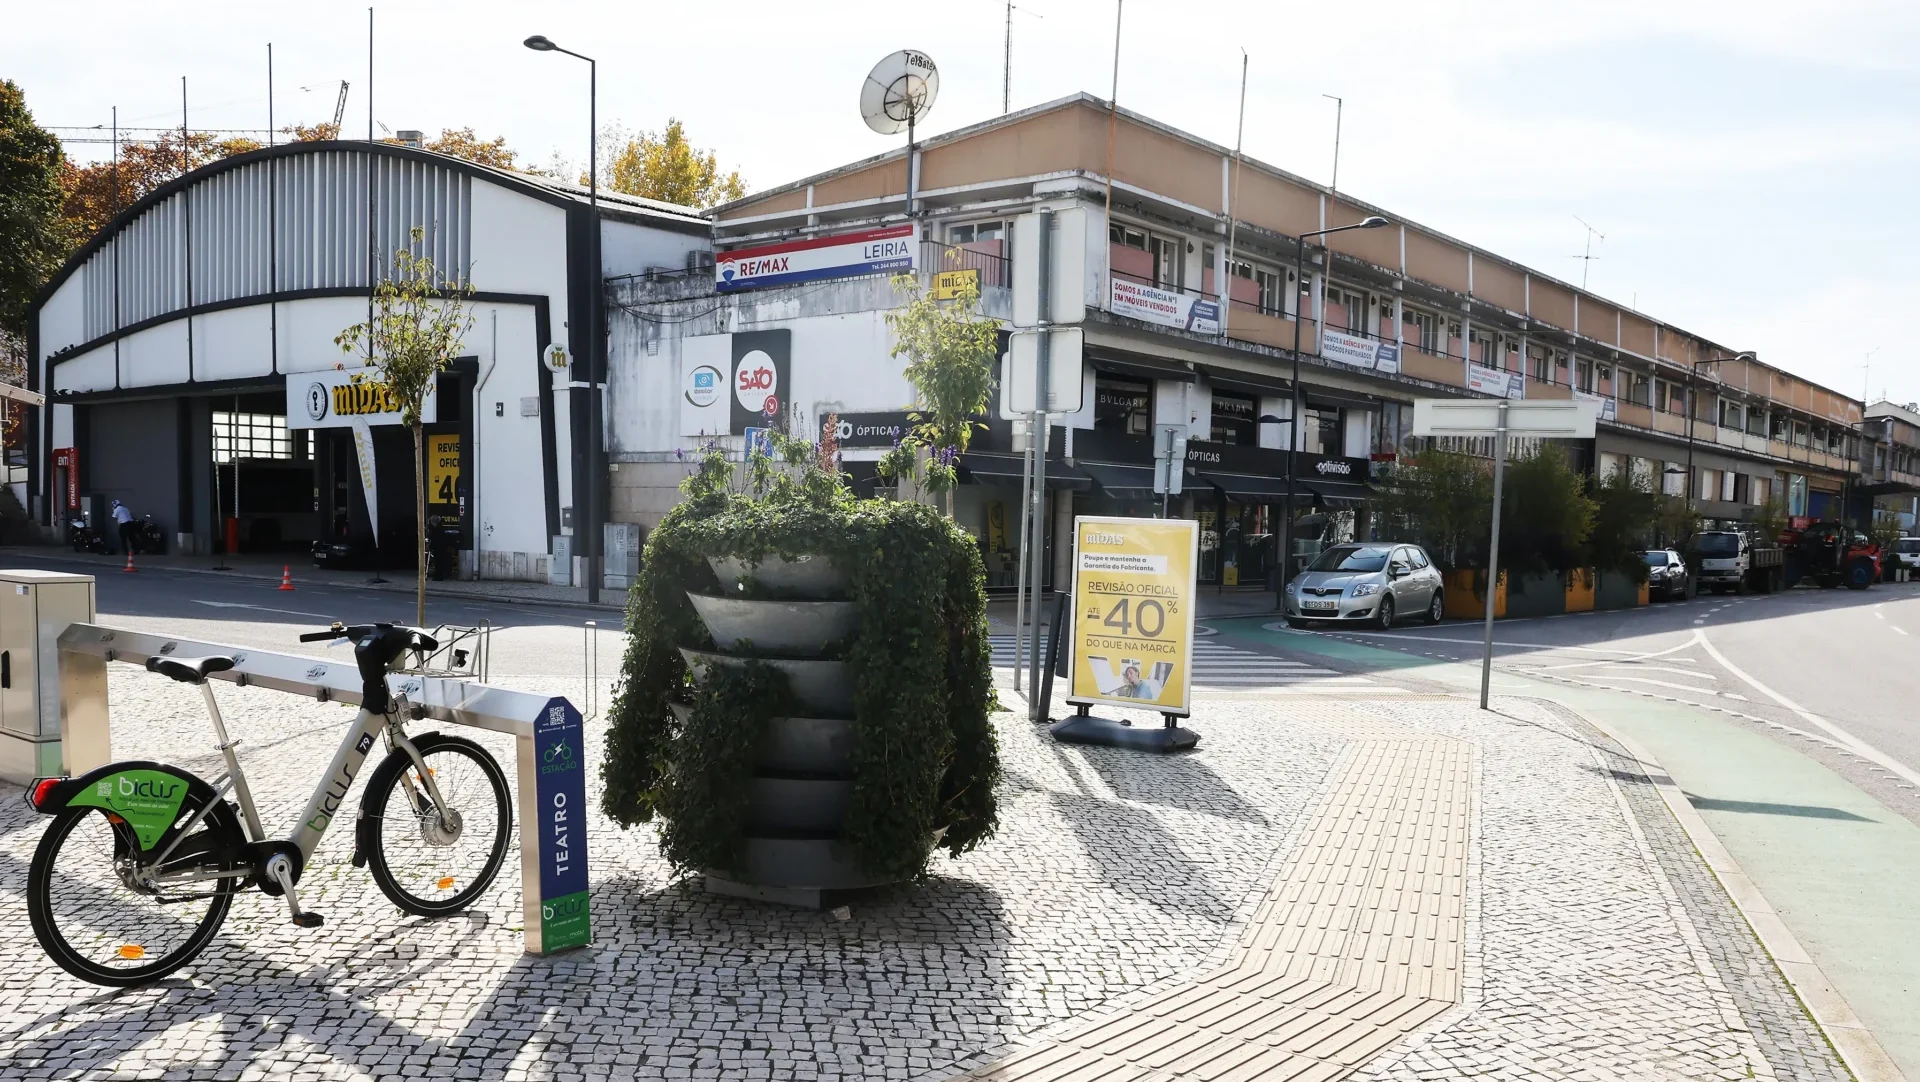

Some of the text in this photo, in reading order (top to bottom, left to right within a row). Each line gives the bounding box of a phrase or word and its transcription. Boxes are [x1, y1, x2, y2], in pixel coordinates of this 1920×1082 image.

[864, 241, 908, 259] LEIRIA
[740, 256, 789, 277] RE/MAX
[1114, 282, 1136, 295] SOMOS
[1141, 289, 1167, 302] AGÊNCIA
[1114, 293, 1124, 301] EM
[1124, 294, 1148, 307] IMÓVEIS
[1148, 300, 1177, 314] VENDIDOS
[1324, 334, 1339, 344] SOMOS
[1343, 338, 1360, 349] AGÊNCIA
[1324, 343, 1345, 354] NEGÓCIOS
[1344, 348, 1372, 360] PARTILHADOS
[1219, 401, 1247, 413] PRADA
[1188, 451, 1220, 463] ÓPTICAS
[1316, 460, 1351, 474] optivisão
[1084, 554, 1104, 562] Poupe
[1109, 555, 1141, 563] mantenha
[1084, 562, 1111, 570] Garantia
[1120, 564, 1156, 572] Fabricante.
[1088, 580, 1179, 596] REVISÃO OFICIAL
[1086, 638, 1176, 654] DO QUE NA MARCA
[359, 737, 370, 750] 79
[541, 760, 577, 775] ESTAÇÃO
[119, 776, 179, 799] biclis
[553, 792, 569, 876] TEATRO
